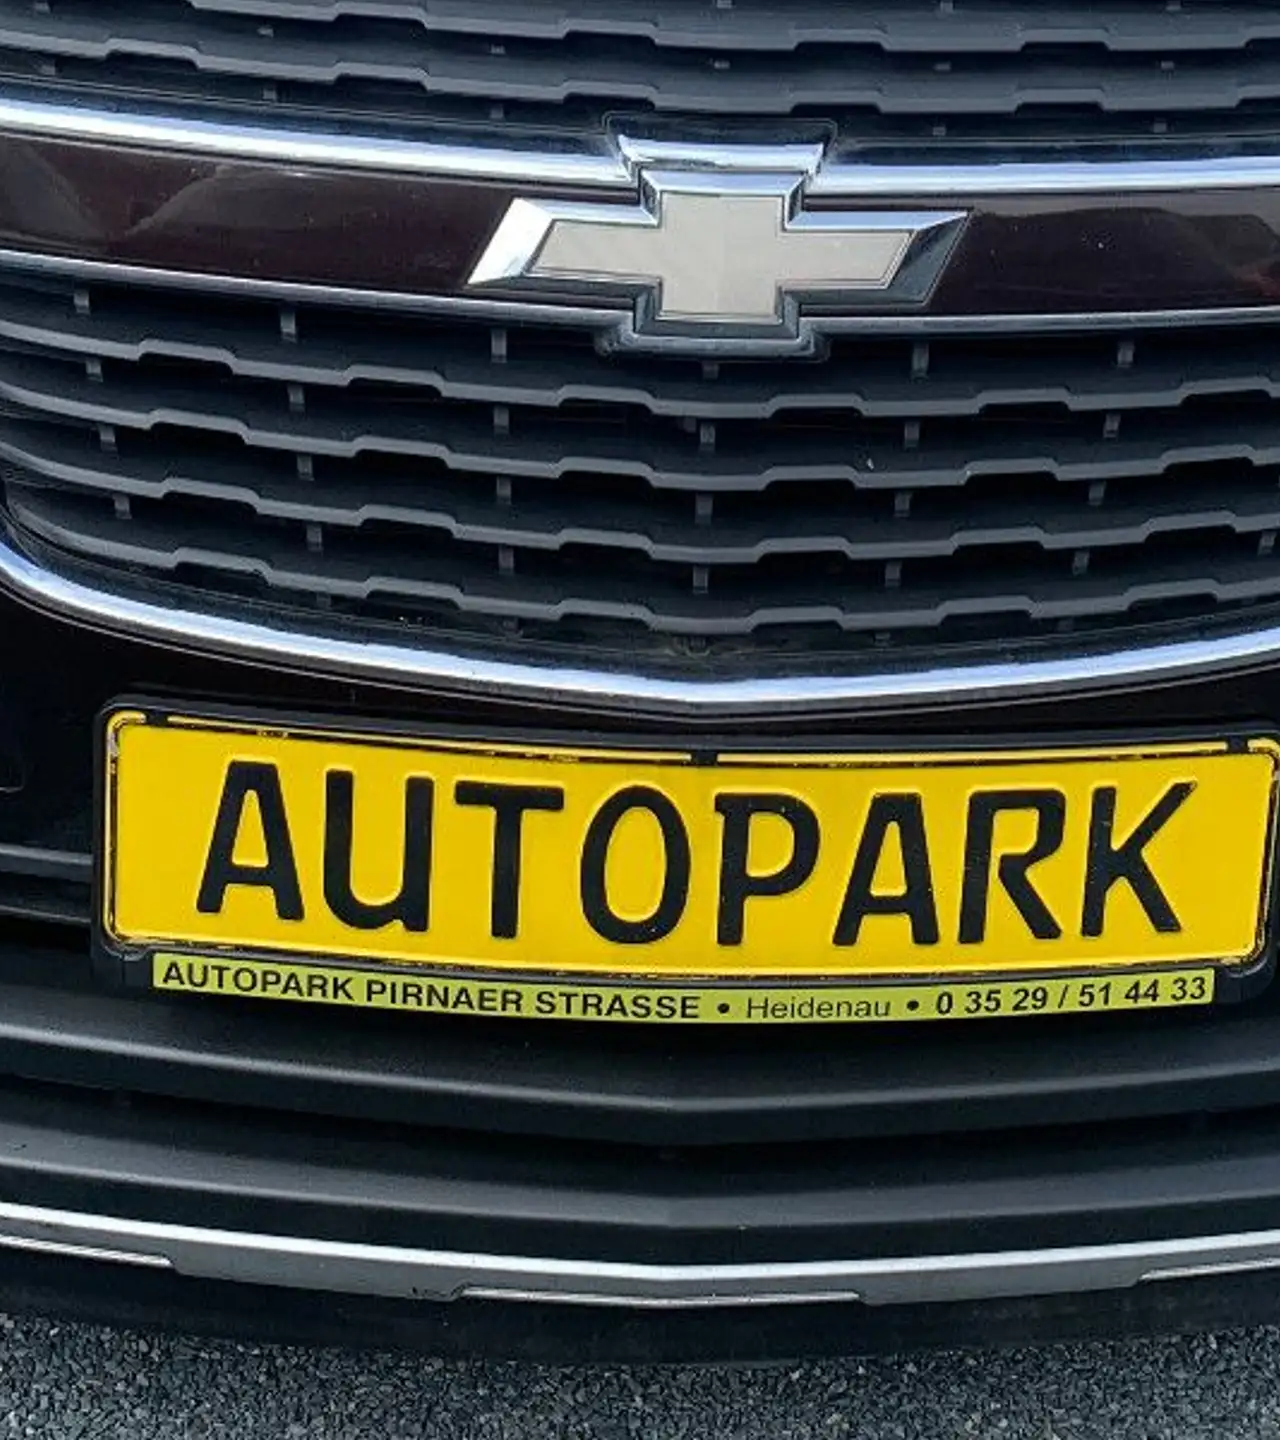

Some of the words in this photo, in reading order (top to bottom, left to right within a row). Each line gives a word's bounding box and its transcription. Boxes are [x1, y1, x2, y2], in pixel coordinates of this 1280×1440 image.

[195, 760, 1198, 948] AUTOPARK
[162, 962, 355, 1001] AUTOPARK
[366, 980, 523, 1012] PIRNAER
[535, 991, 702, 1019] STRASSE
[747, 996, 891, 1019] Heidenau
[936, 991, 953, 1015] 0
[965, 989, 1002, 1013] 35
[1012, 986, 1048, 1011] 29
[1078, 982, 1112, 1007] 51
[1124, 979, 1160, 1004] 44
[1170, 976, 1206, 1001] 33
